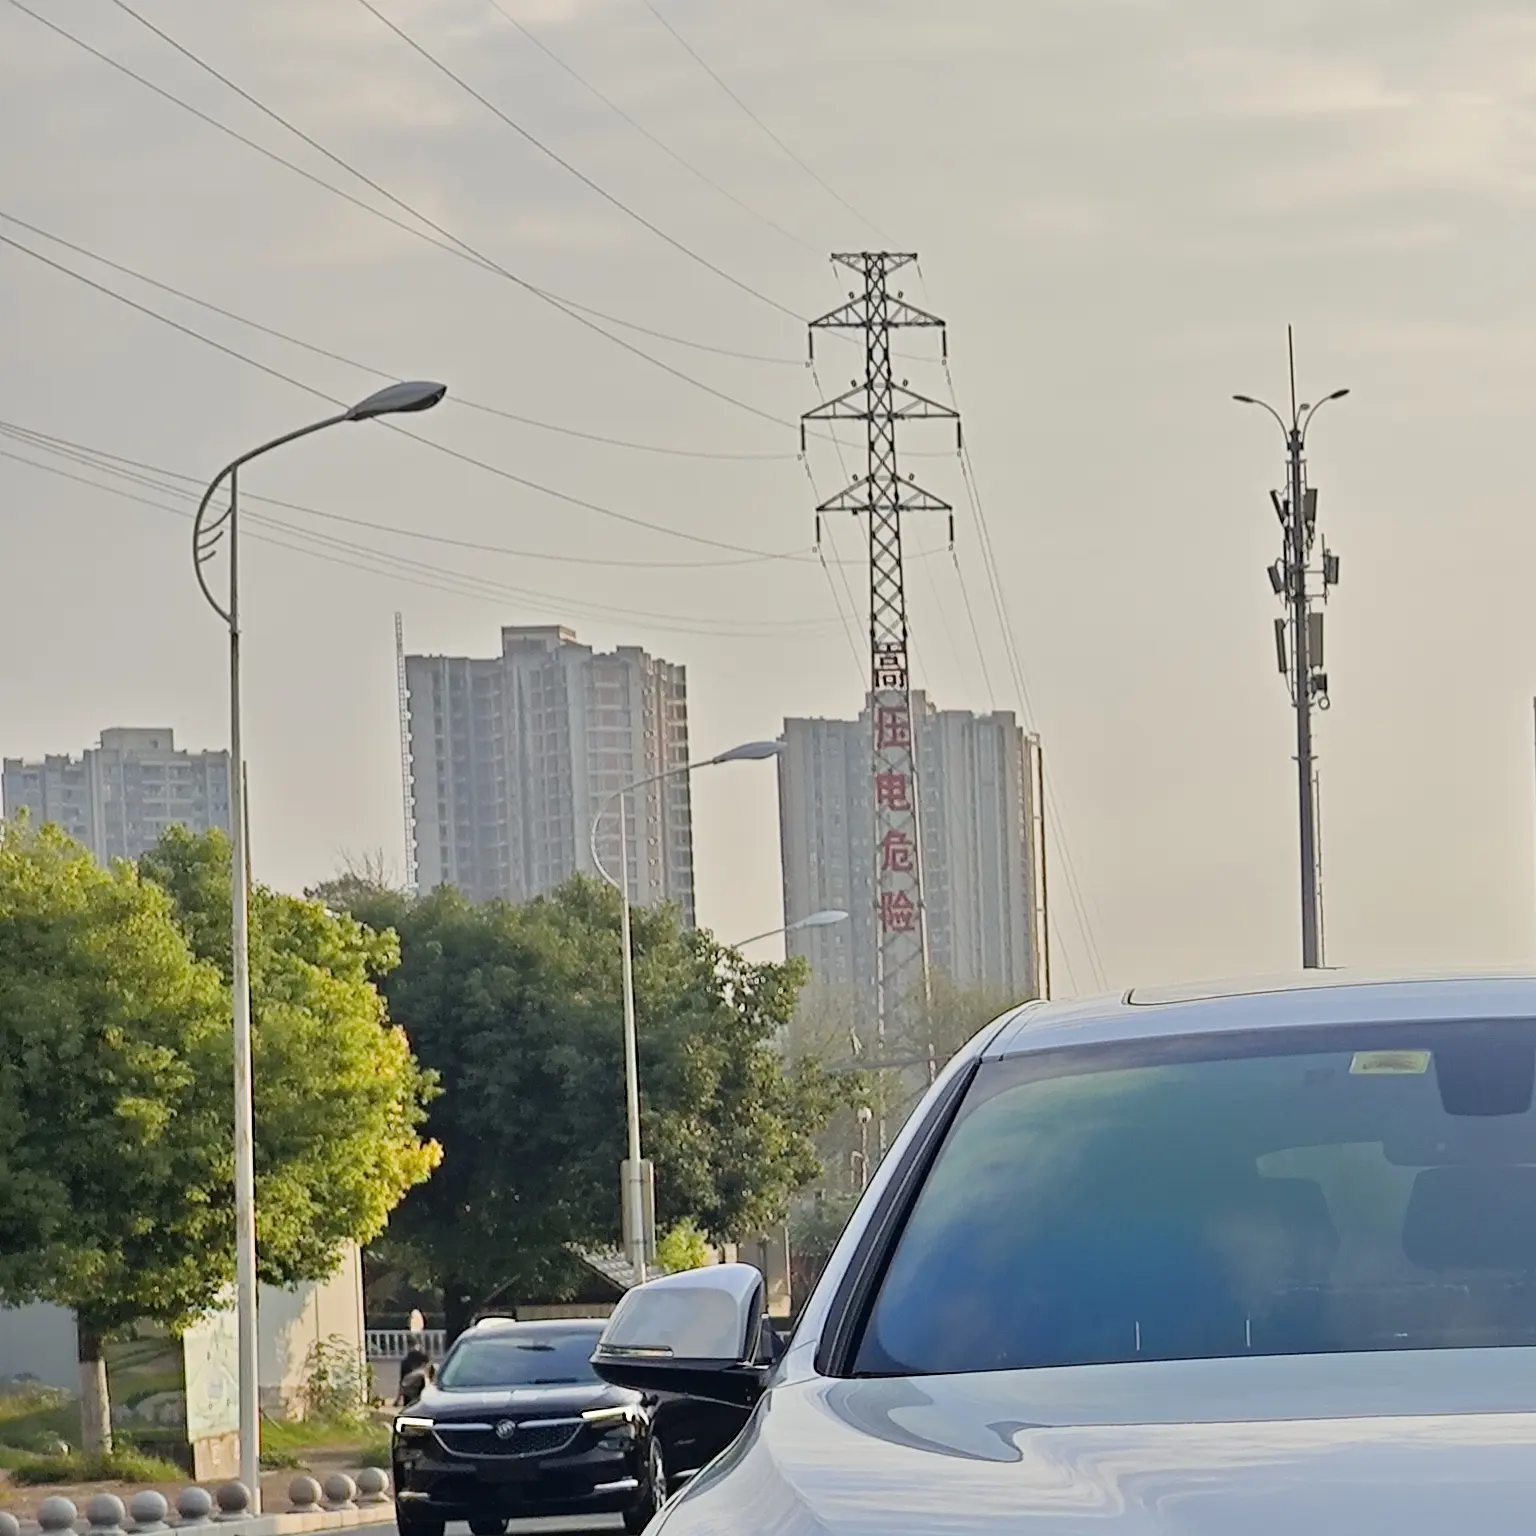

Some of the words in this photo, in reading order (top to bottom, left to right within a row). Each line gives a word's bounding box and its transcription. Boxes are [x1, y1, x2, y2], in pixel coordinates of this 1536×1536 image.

[874, 641, 916, 933] 高压电危险
